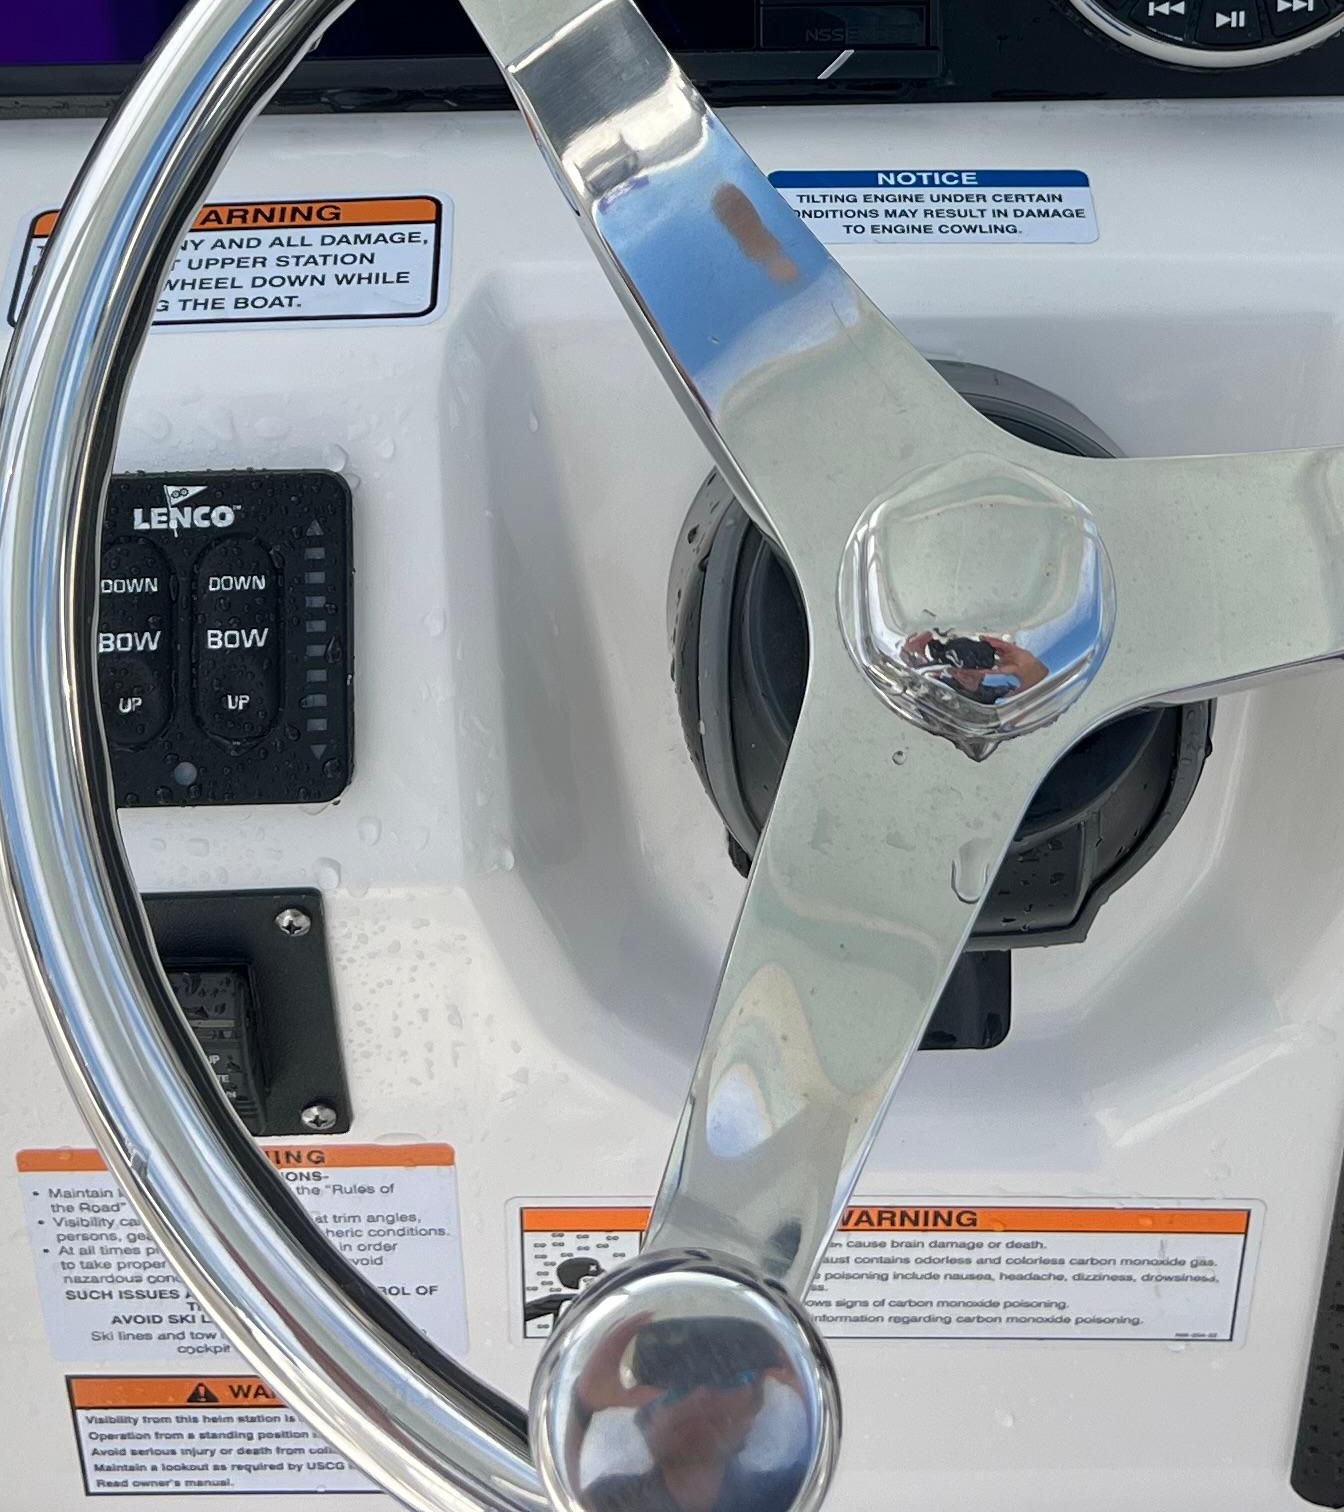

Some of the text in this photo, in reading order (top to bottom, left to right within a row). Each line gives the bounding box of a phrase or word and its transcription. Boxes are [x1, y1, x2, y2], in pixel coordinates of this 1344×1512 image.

[877, 172, 979, 186] NOTICE
[796, 193, 1063, 204] TILTING ENGINE UNDER CERTAIN
[200, 204, 342, 226] ARNING
[794, 208, 1086, 219] ONDITIONS MAY RESULT IN DAMAGE
[843, 224, 1023, 235] TO ENGINE COWLING.
[210, 237, 262, 251] AND
[268, 235, 313, 249] ALL
[320, 231, 429, 248] DAMAGE,
[187, 252, 376, 271] UPPER STATION
[251, 274, 327, 289] DOWN
[333, 271, 411, 286] WHILE
[178, 297, 227, 312] THE
[234, 295, 302, 310] BOAT.
[134, 505, 235, 530] LENCO
[101, 574, 266, 594] DOWN DOWN
[98, 628, 269, 653] BOW BOW
[119, 694, 250, 714] UP UP
[296, 1185, 321, 1196] the
[379, 1183, 394, 1194] of
[51, 1203, 75, 1213] the
[332, 1213, 422, 1225] trim angles,
[847, 1240, 1047, 1250] cause brain damage or death.
[65, 1290, 113, 1301] SUCH
[118, 1290, 180, 1300] ISSUES
[111, 1314, 196, 1325] AVOID SKI
[92, 1330, 217, 1341] Ski lines and tow
[177, 1344, 231, 1355] cockpit
[96, 1478, 235, 1488] Read owner's manual.
